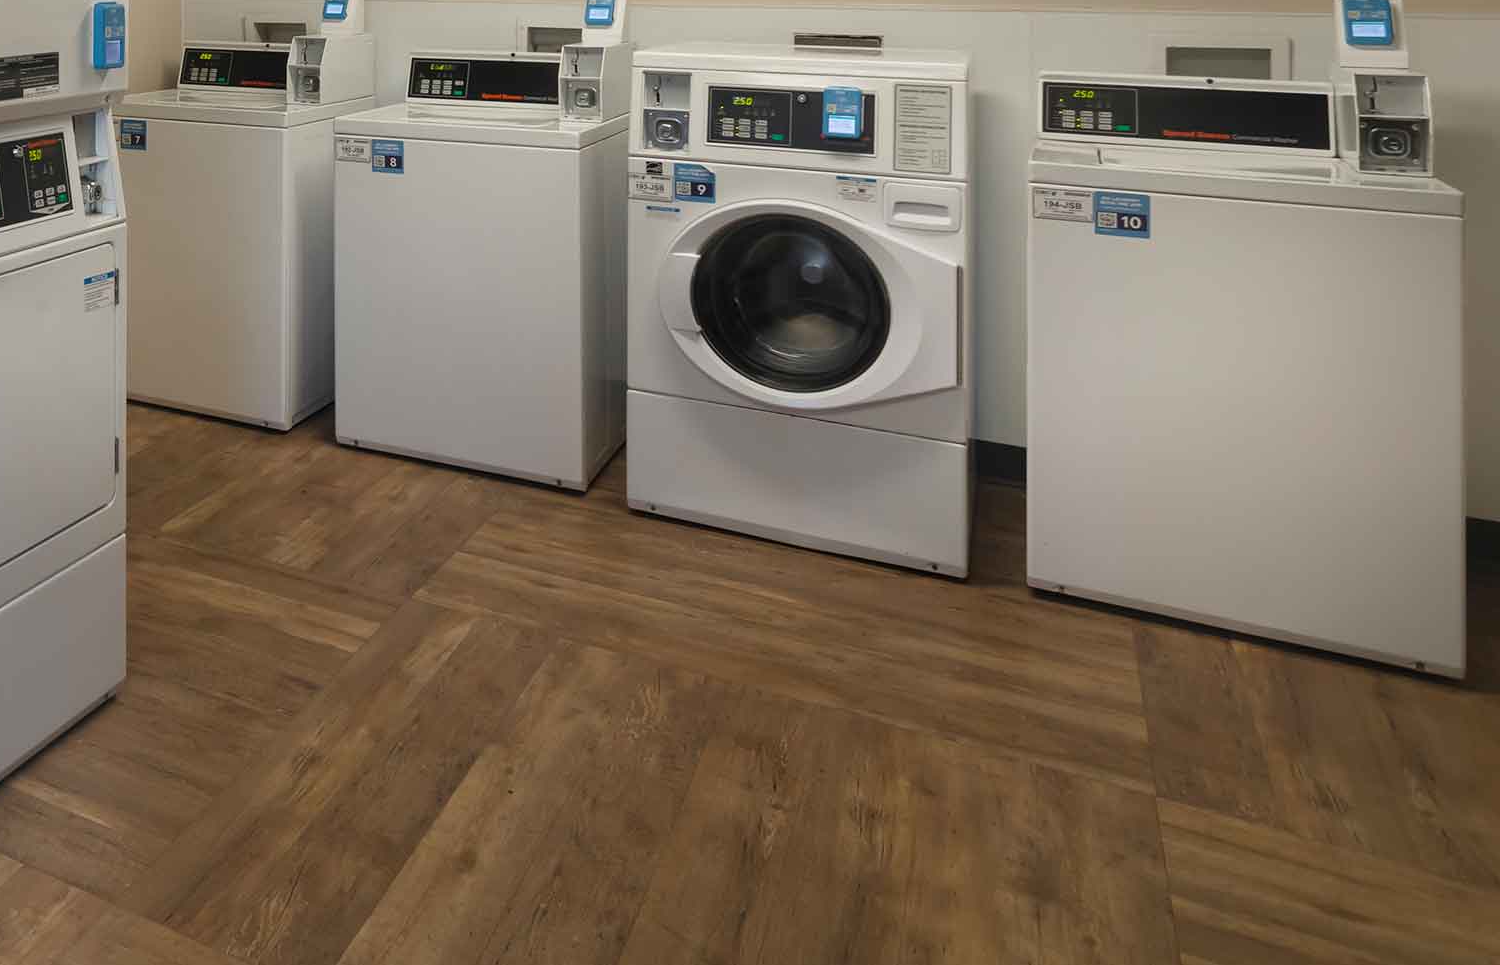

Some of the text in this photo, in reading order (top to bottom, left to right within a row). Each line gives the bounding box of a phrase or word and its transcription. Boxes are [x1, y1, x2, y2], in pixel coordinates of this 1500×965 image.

[389, 156, 397, 167] 8
[697, 184, 707, 196] 9
[1120, 216, 1142, 230] 10
